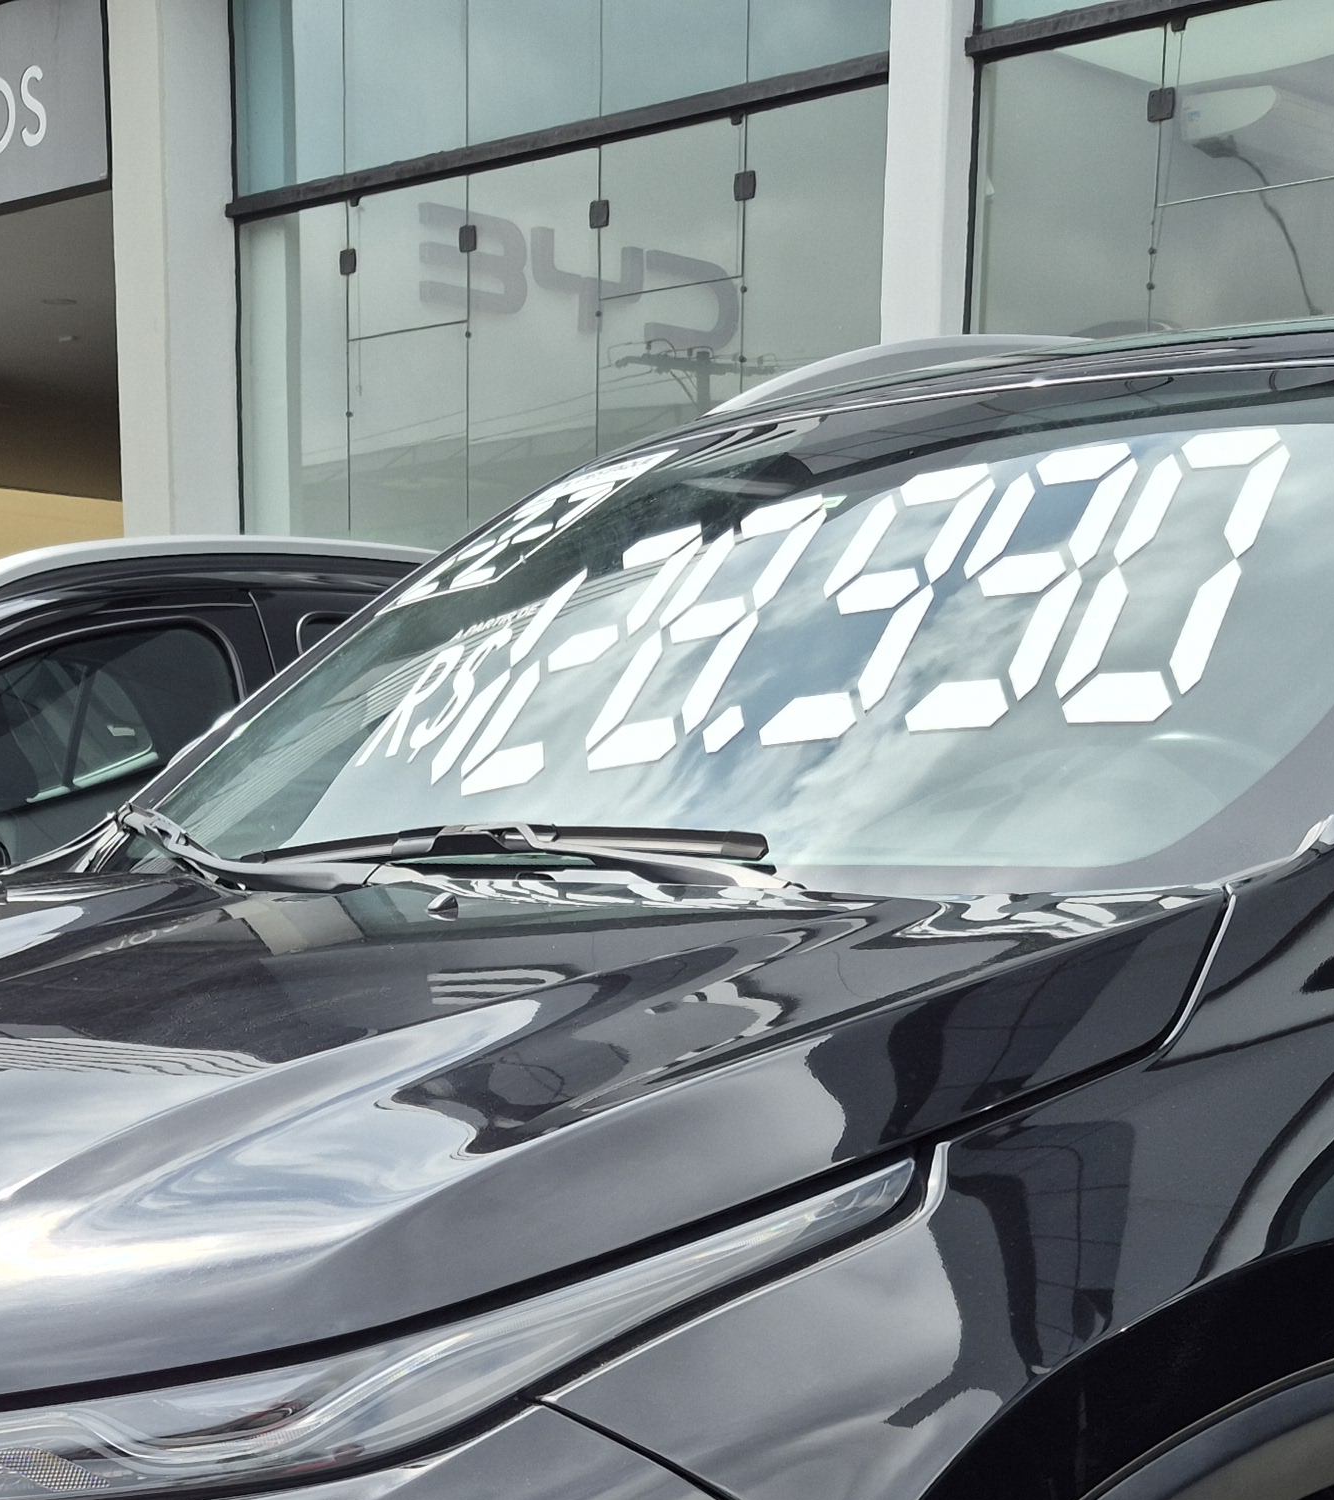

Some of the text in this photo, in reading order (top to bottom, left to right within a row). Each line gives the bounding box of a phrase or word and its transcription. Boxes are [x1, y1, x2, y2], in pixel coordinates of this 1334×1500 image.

[418, 202, 740, 352] BYD
[463, 613, 515, 639] PARTIR
[517, 603, 543, 618] DE
